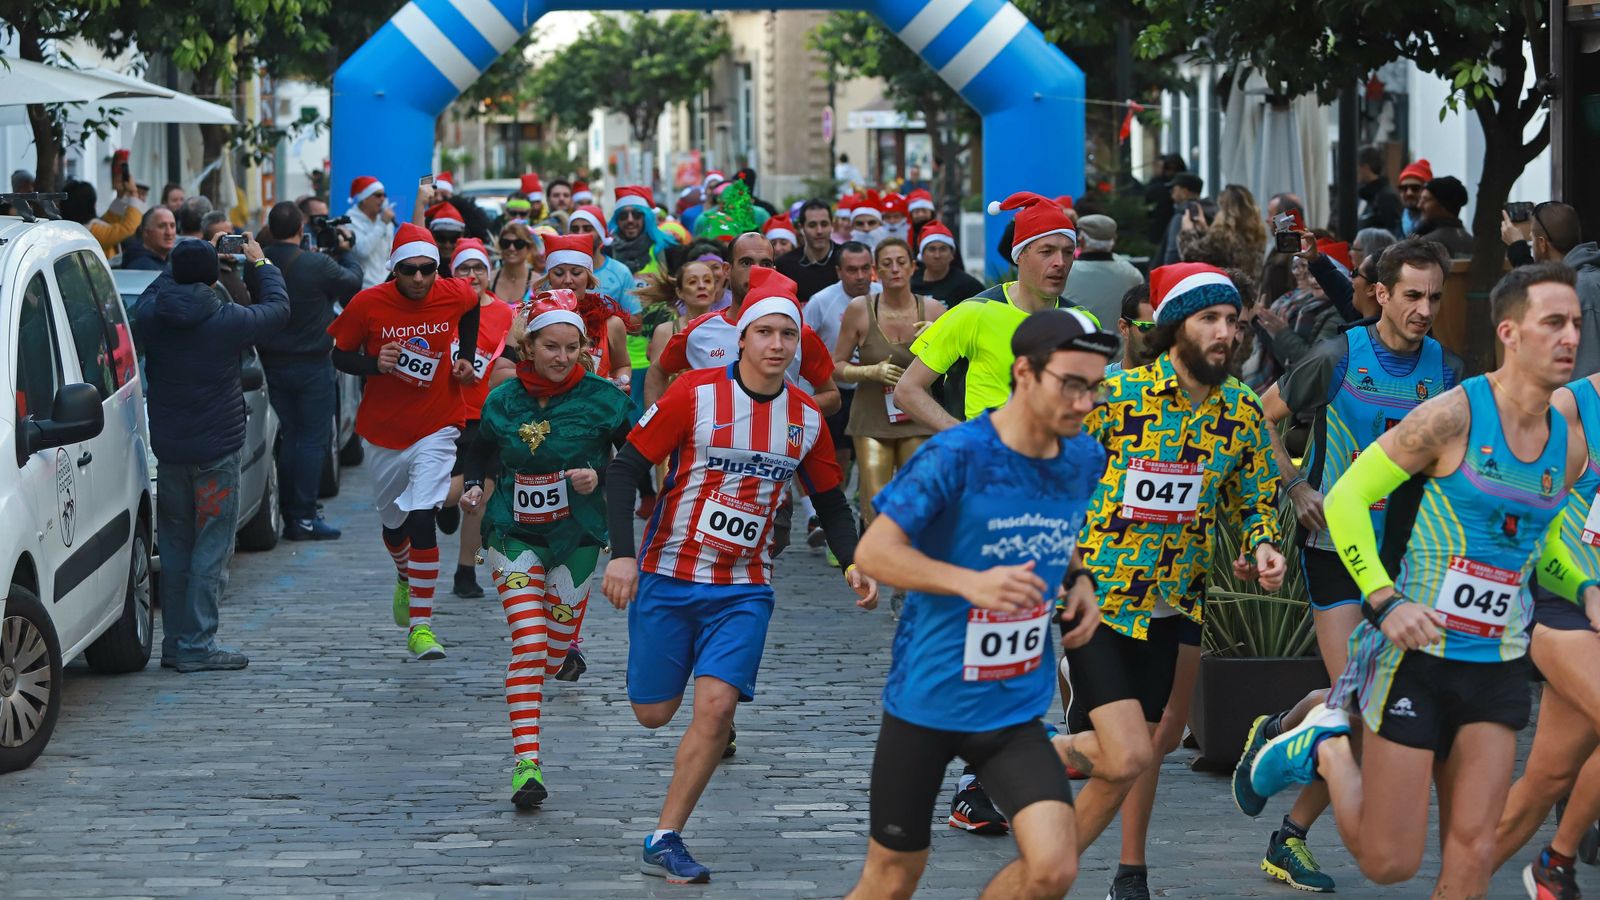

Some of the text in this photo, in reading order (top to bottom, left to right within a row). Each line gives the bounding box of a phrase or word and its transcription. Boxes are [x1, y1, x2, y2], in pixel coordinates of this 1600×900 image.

[382, 322, 449, 339] Manduka
[398, 353, 433, 376] 068
[710, 348, 725, 359] edp
[764, 456, 782, 464] Trade
[518, 488, 560, 508] 005
[1136, 479, 1193, 504] 047
[709, 511, 759, 541] 006
[1453, 583, 1511, 617] 045
[981, 626, 1040, 657] 016
